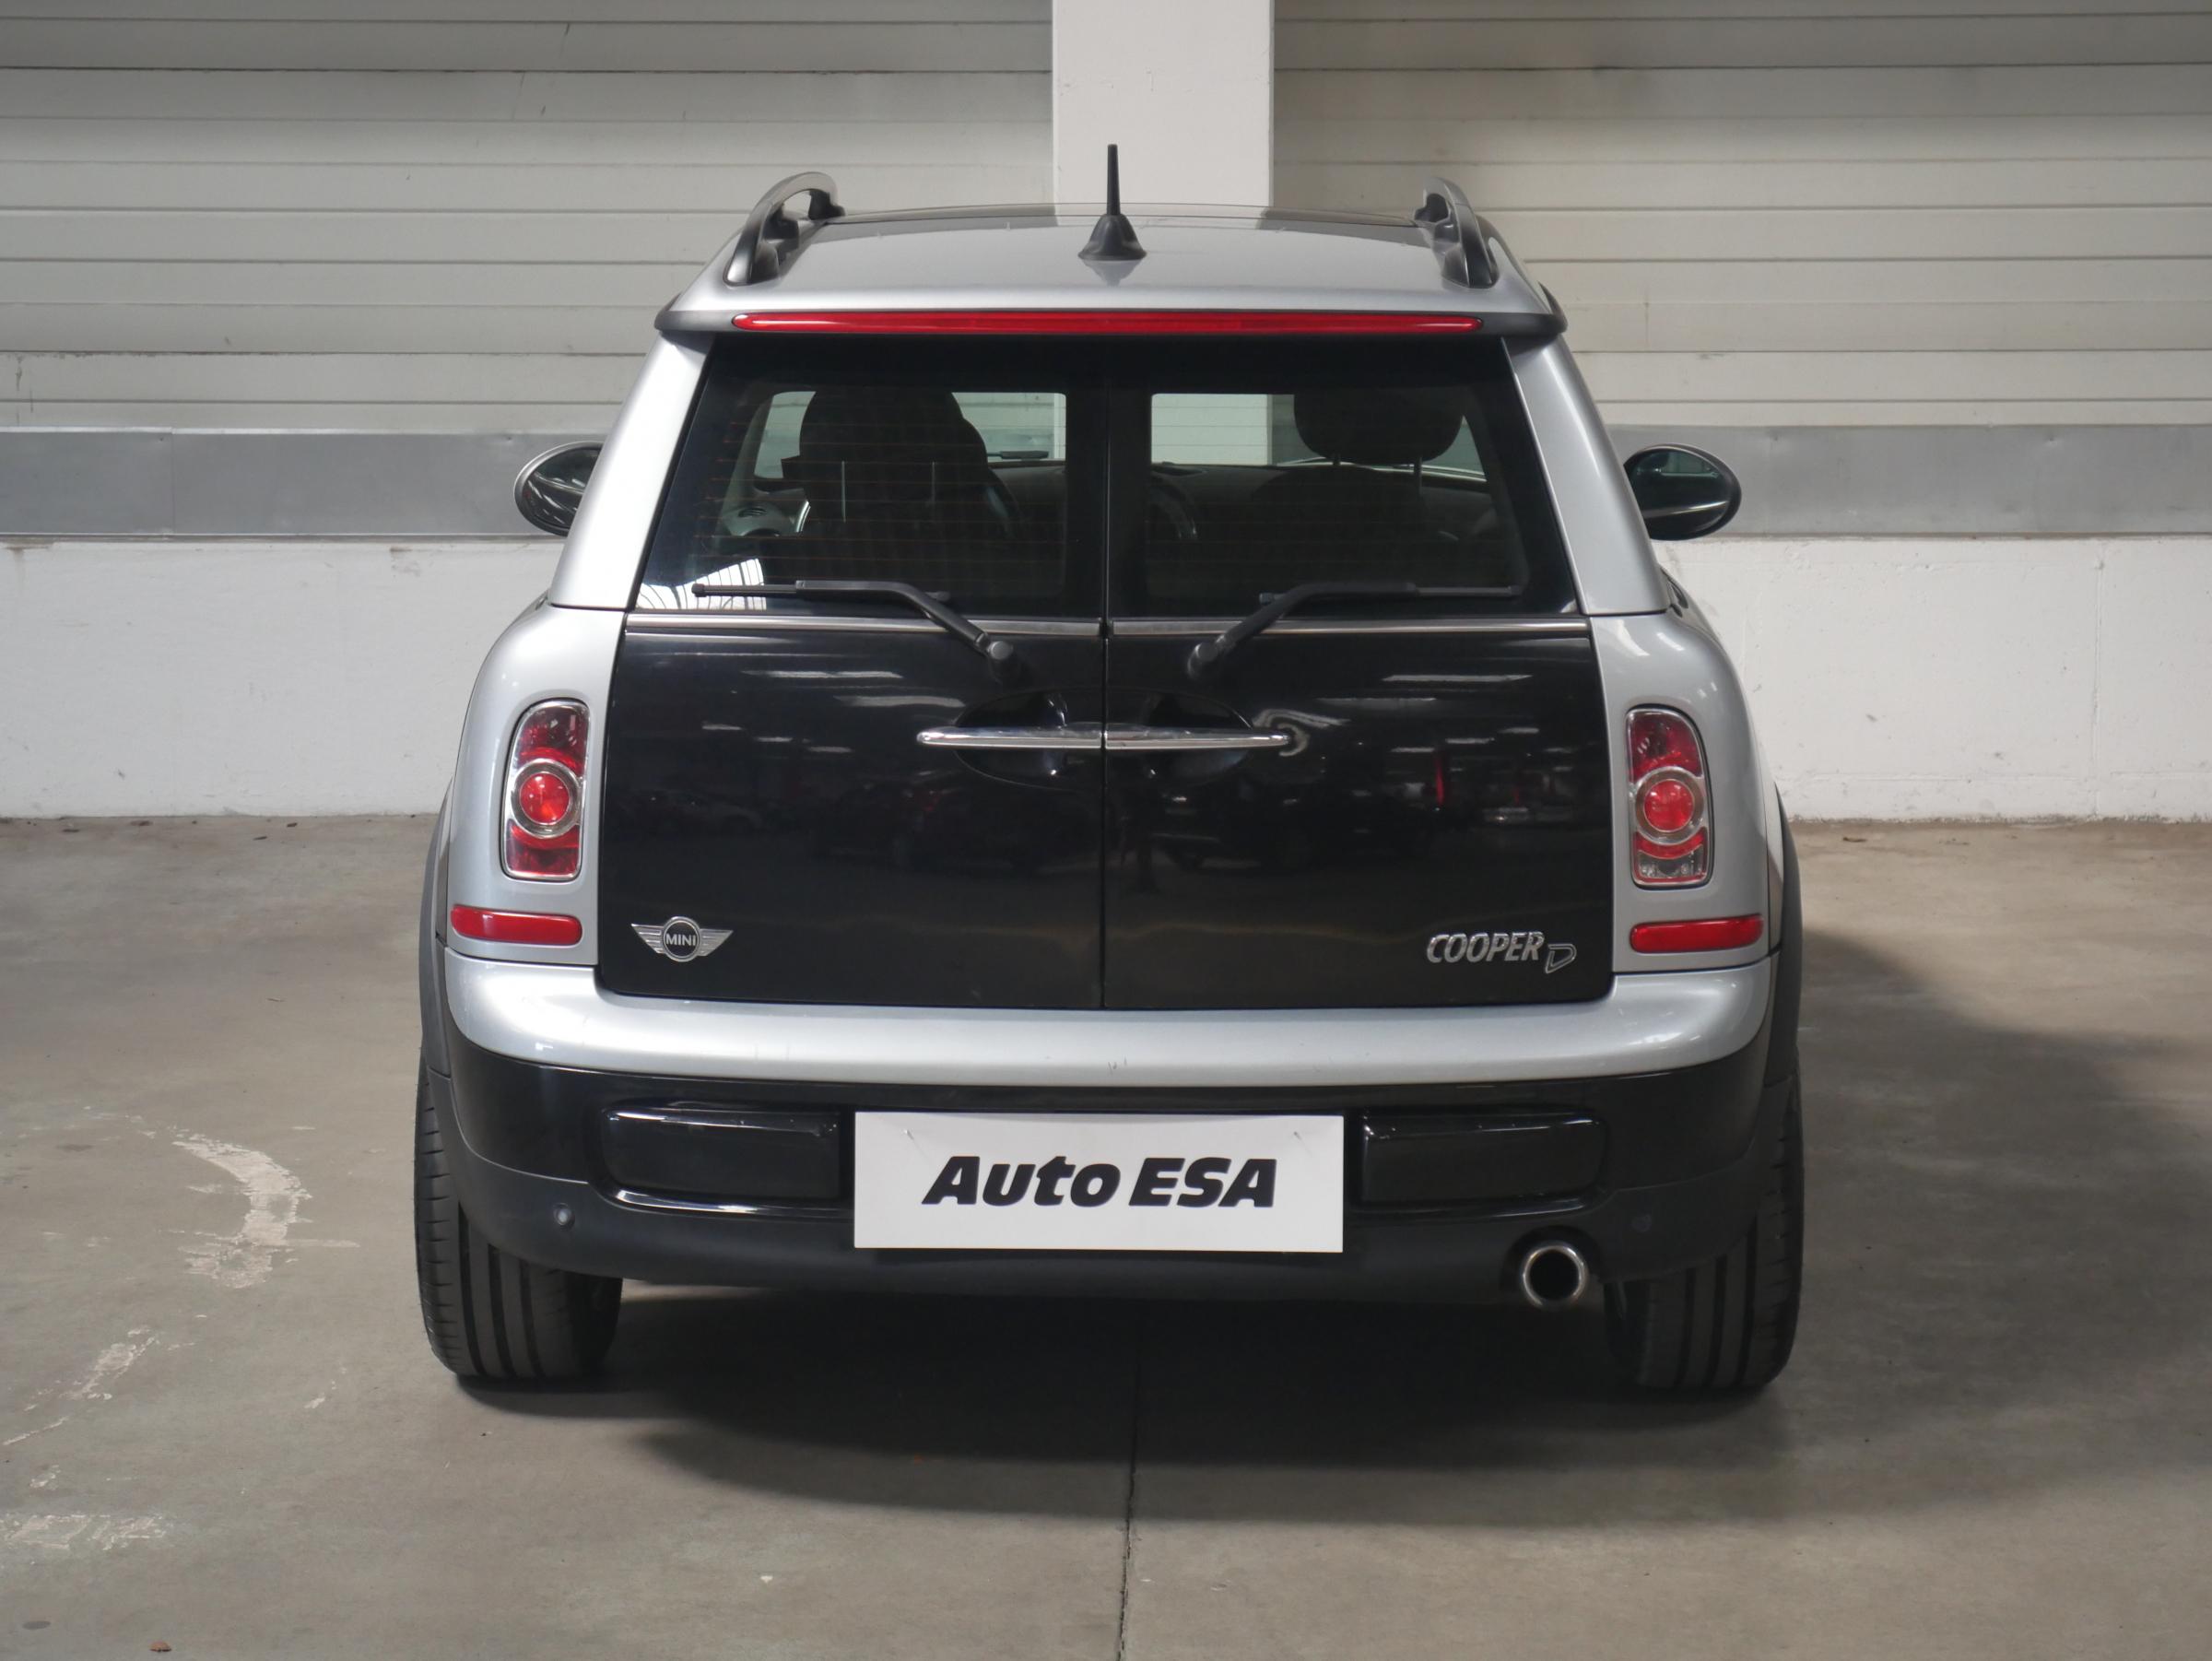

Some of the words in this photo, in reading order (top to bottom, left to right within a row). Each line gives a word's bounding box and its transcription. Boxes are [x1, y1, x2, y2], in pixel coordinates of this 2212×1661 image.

[665, 933, 697, 947] MINI
[1427, 931, 1545, 963] COOPER
[1545, 943, 1577, 974] D
[921, 1155, 1122, 1207] Auto
[1128, 1157, 1277, 1207] ESA
